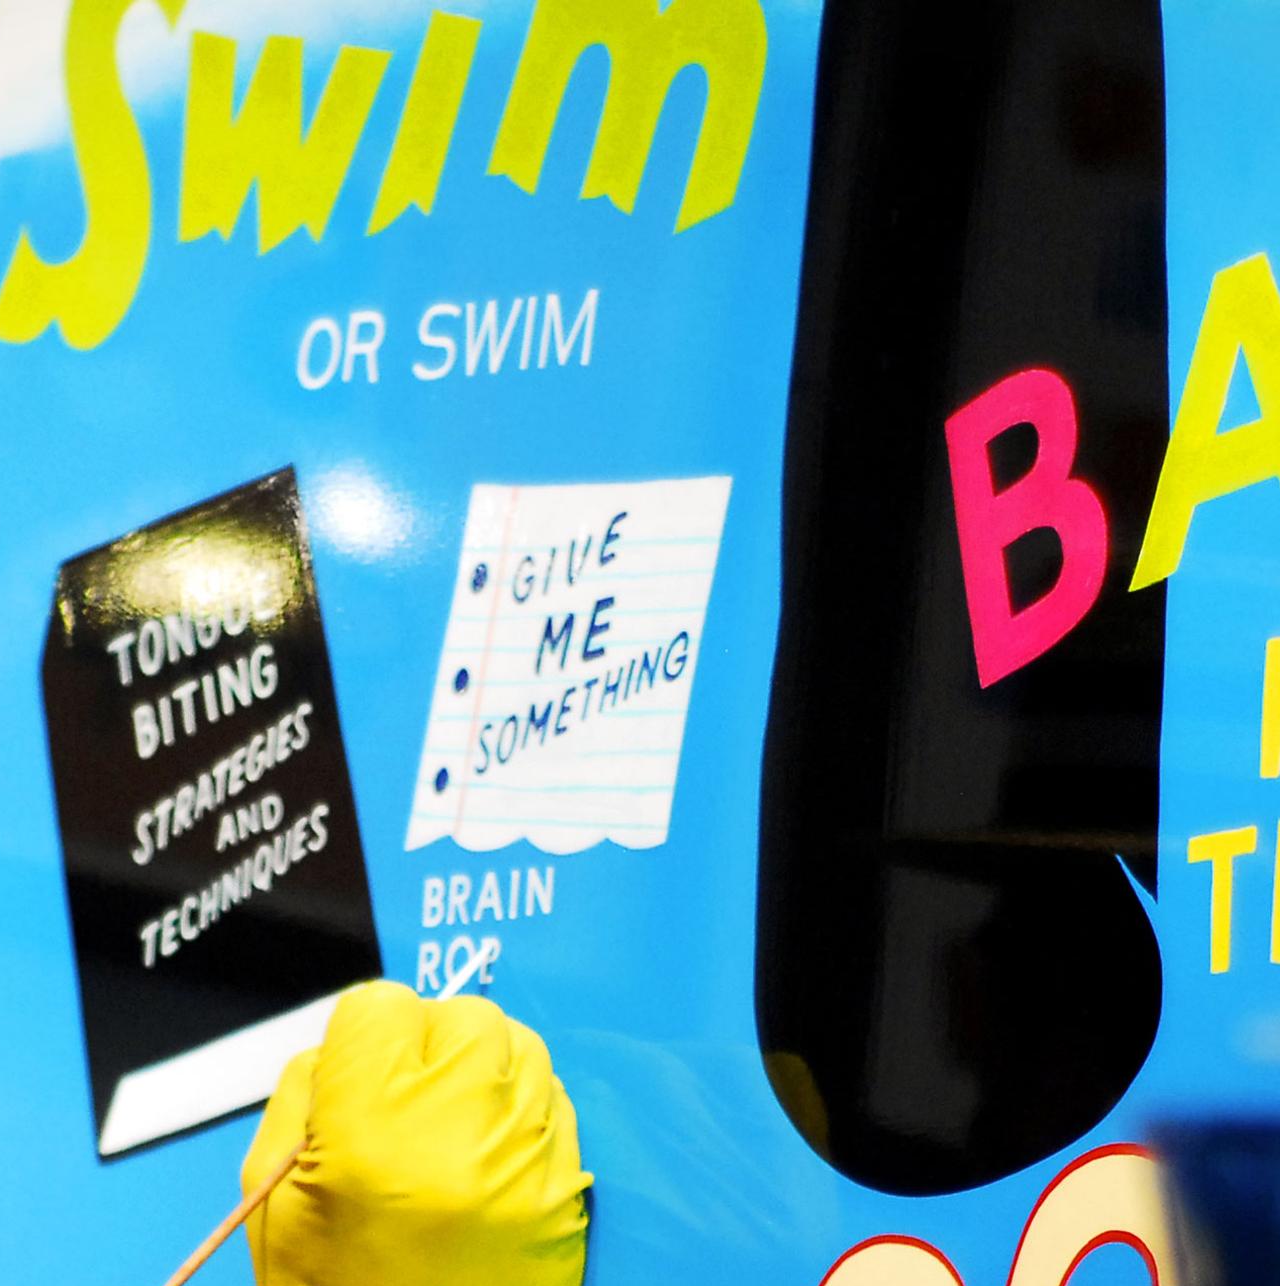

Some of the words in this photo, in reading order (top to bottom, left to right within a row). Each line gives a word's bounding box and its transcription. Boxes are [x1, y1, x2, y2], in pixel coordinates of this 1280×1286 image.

[296, 310, 386, 390] OR
[411, 287, 600, 381] SWIM
[513, 510, 627, 604] GIVE
[535, 597, 615, 676] ME
[132, 644, 278, 760] BITING
[475, 629, 688, 774] SOMETHING
[131, 702, 313, 866] STRATEGIES
[216, 795, 283, 852] AND
[140, 805, 329, 968] TECHNIQUES
[422, 866, 555, 928] BRAIN
